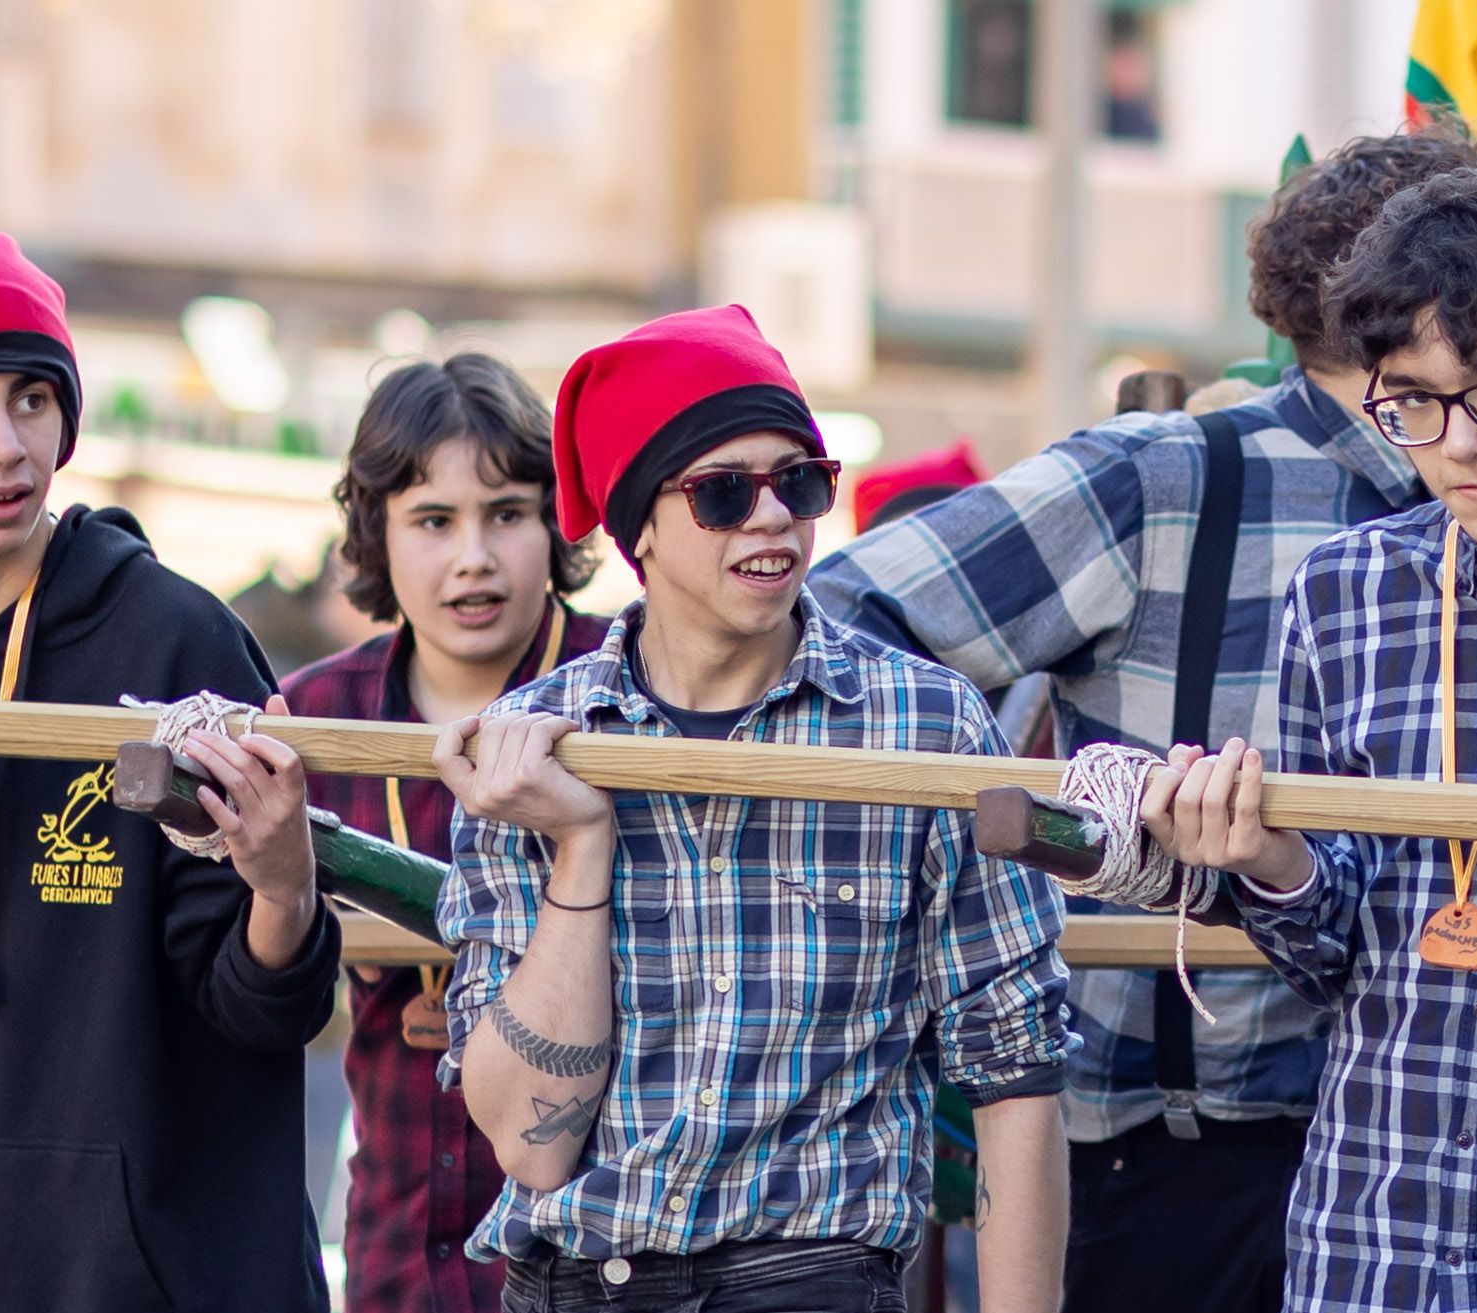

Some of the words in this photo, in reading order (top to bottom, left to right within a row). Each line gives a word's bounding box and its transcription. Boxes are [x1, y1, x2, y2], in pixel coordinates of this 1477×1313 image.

[31, 863, 70, 886] FURES
[73, 865, 79, 886] I
[81, 863, 123, 888] DIABLES
[41, 886, 113, 905] CERDANYOLA
